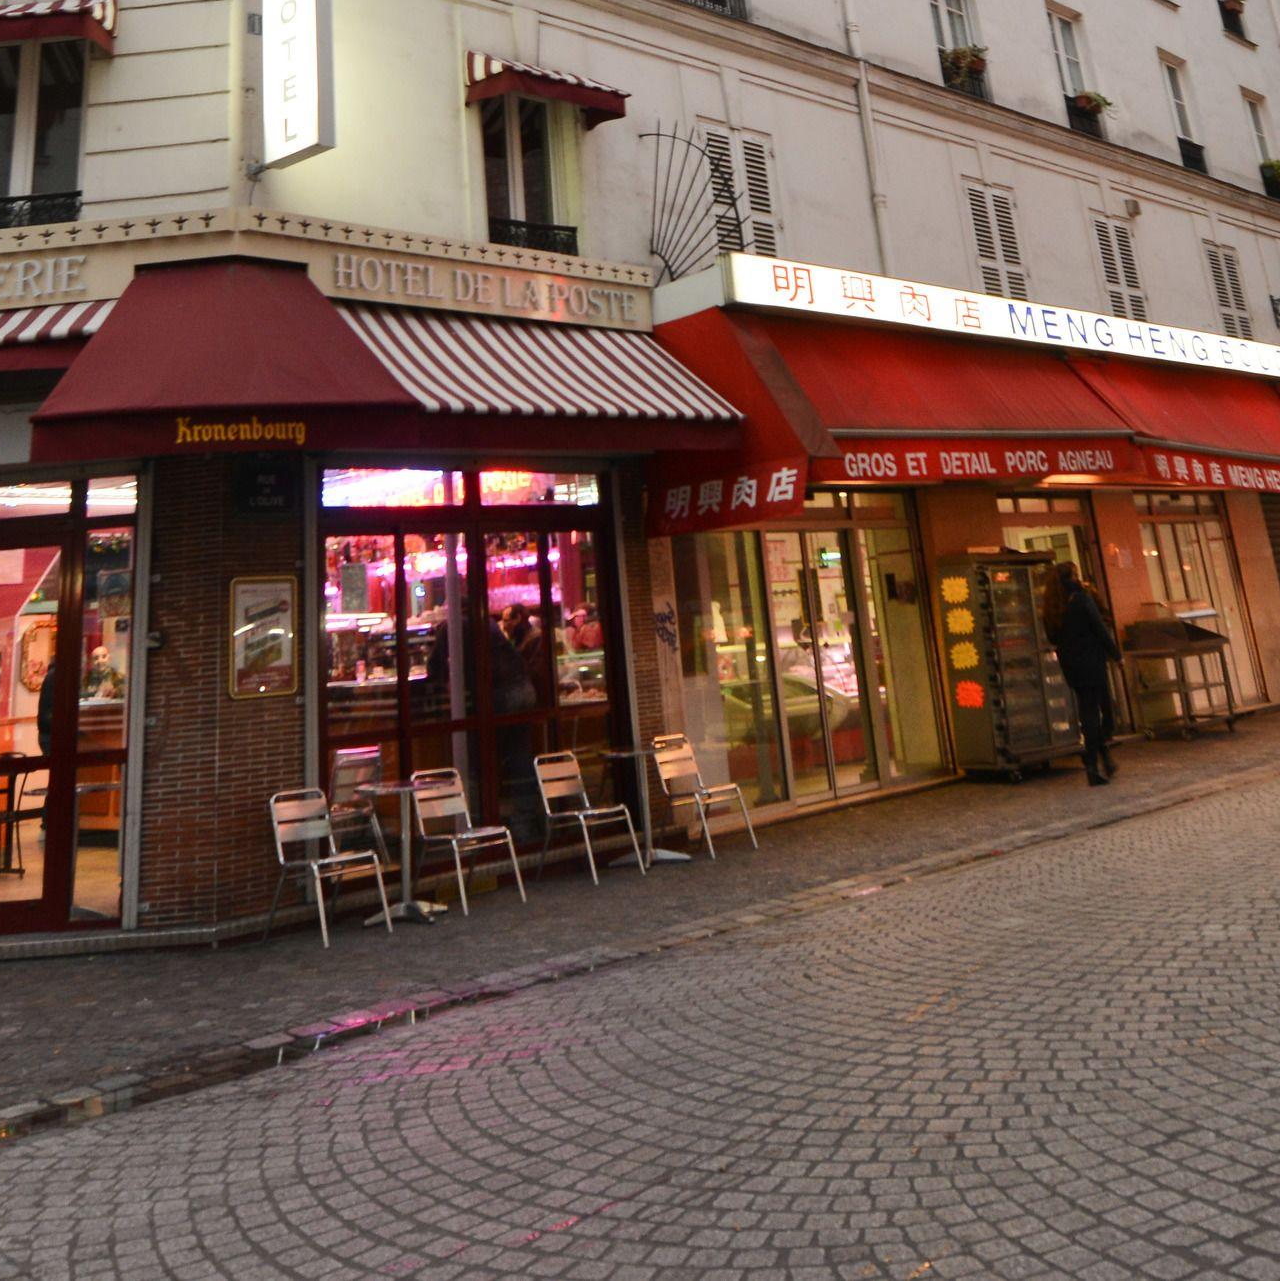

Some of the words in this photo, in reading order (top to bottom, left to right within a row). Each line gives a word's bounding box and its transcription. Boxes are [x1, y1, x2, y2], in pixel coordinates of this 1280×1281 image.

[335, 252, 445, 299] HOTEL
[455, 269, 496, 305] DE
[504, 275, 545, 312] LA
[547, 282, 638, 323] POSTE
[772, 264, 984, 330] 明興肉店
[1007, 303, 1115, 348] MENG
[1127, 323, 1209, 362] HENG
[175, 416, 307, 446] Kronenbourg
[844, 451, 898, 478] GROS
[905, 451, 928, 477] ET
[940, 450, 997, 475] DETAIL
[1004, 449, 1049, 474] PORC
[1058, 449, 1115, 472] AGNEAU
[1227, 463, 1265, 489] MENG
[664, 466, 798, 519] 明興肉店
